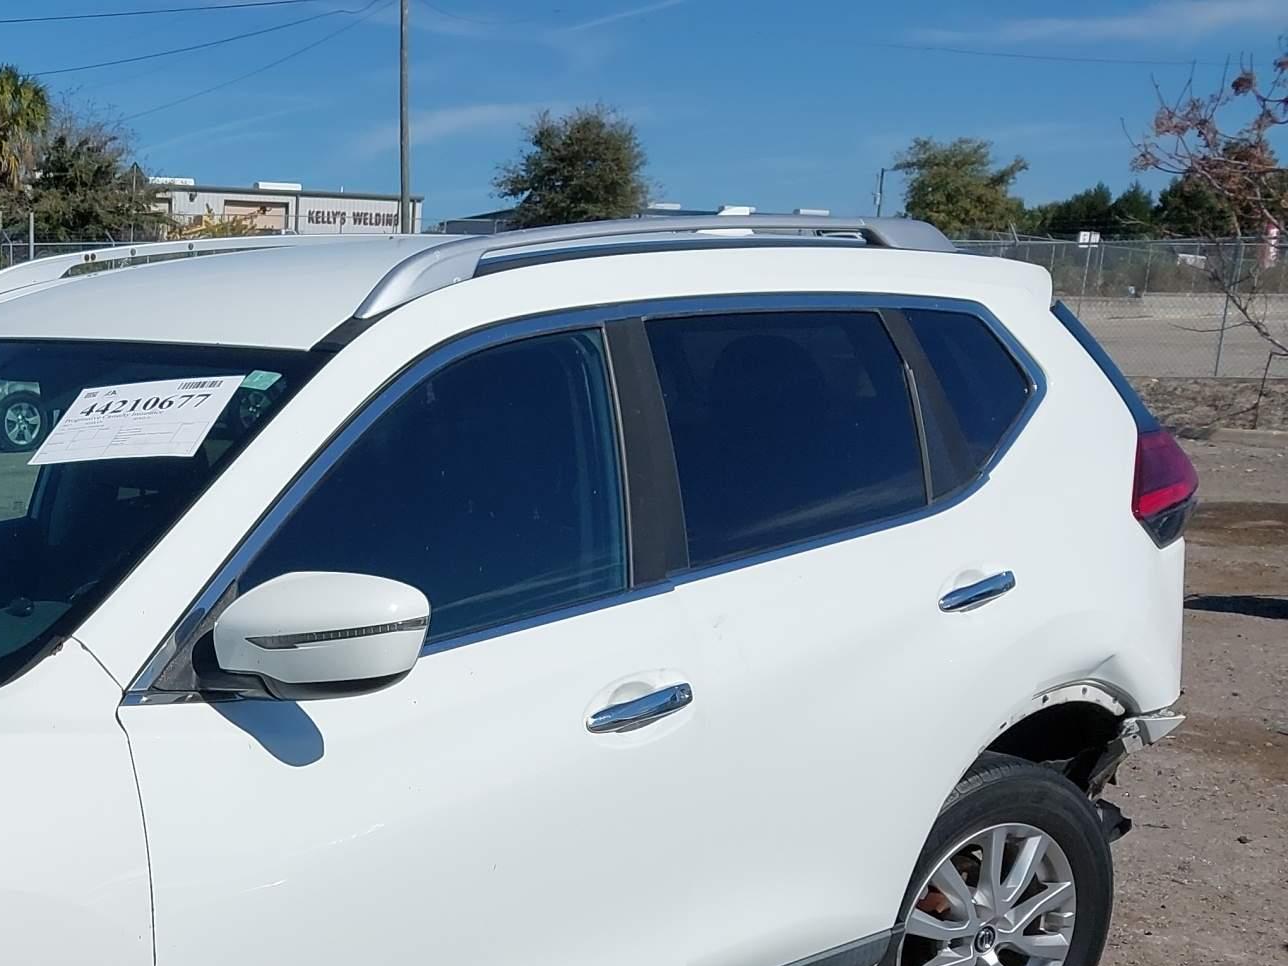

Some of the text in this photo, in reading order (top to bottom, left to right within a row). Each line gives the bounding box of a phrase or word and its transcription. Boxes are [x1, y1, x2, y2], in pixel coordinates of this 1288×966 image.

[307, 210, 399, 227] KELLY'S WELDING
[80, 393, 212, 416] 44210677
